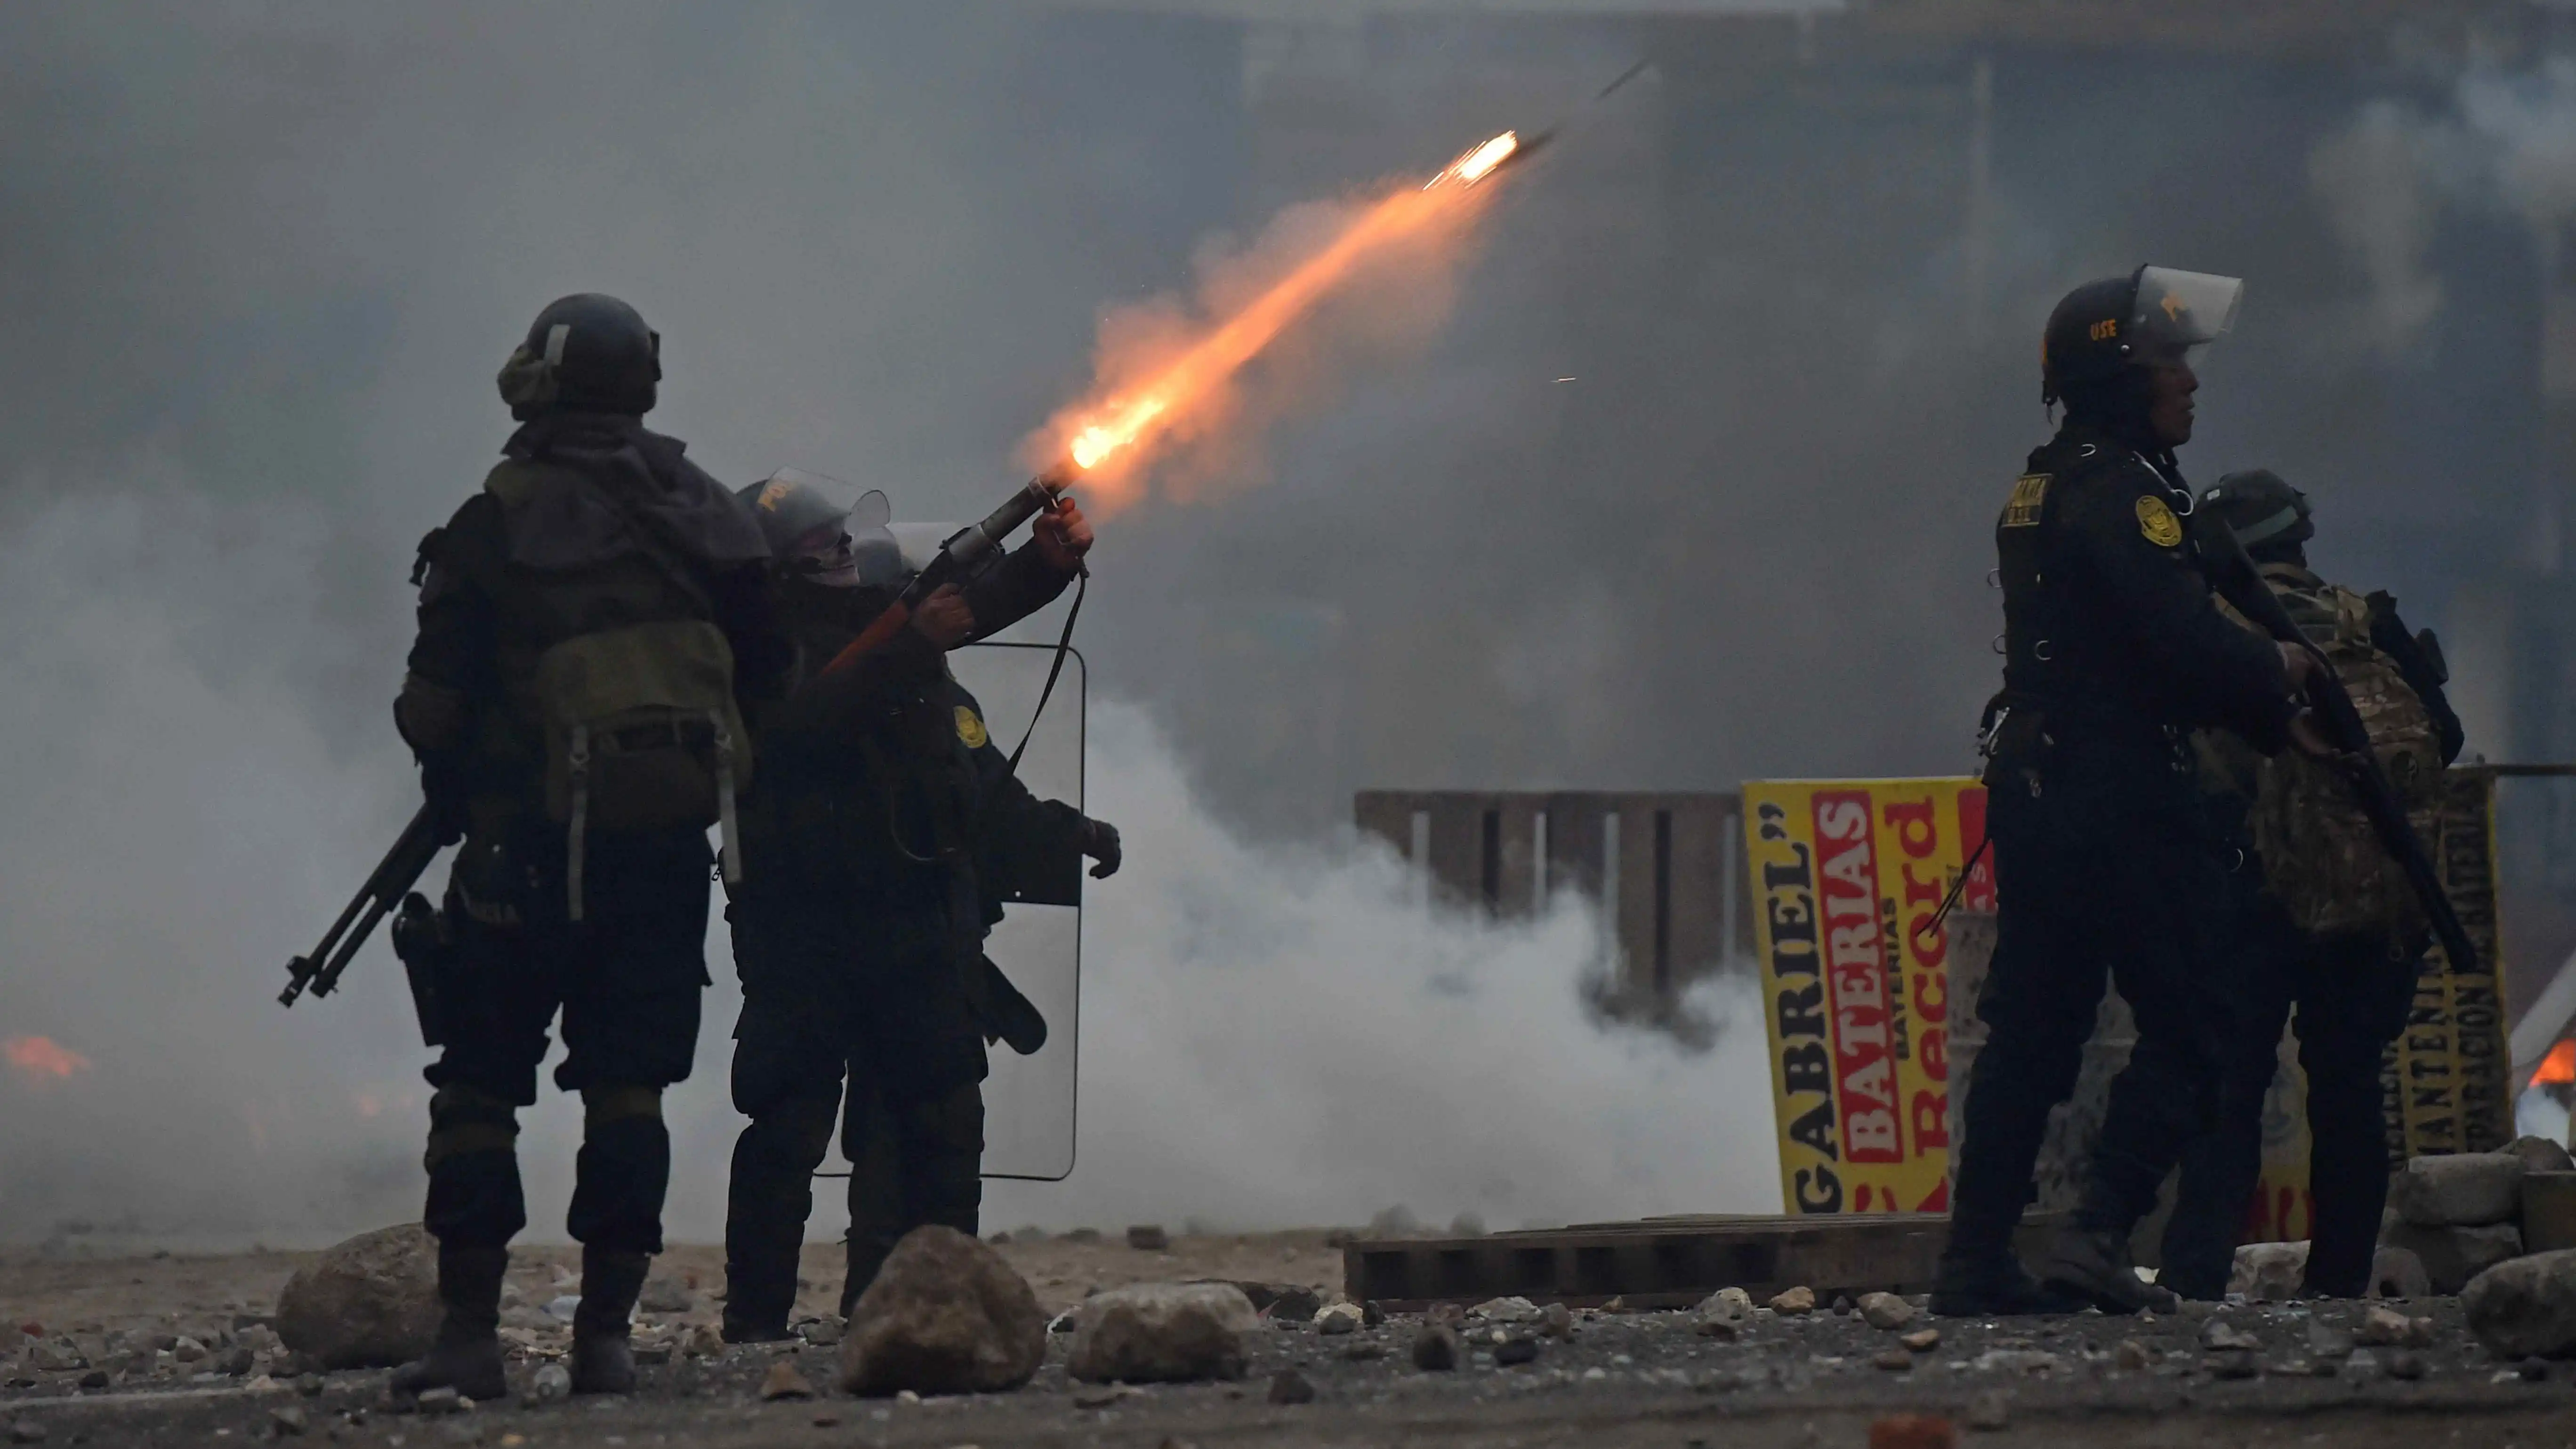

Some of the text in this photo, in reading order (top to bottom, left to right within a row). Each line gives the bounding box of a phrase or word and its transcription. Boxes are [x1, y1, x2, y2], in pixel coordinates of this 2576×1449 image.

[2090, 319, 2117, 341] USE
[1817, 799, 1898, 1154] BATERIAS
[1880, 896, 1909, 1061] BATERIAS
[1884, 794, 1948, 1158] Record
